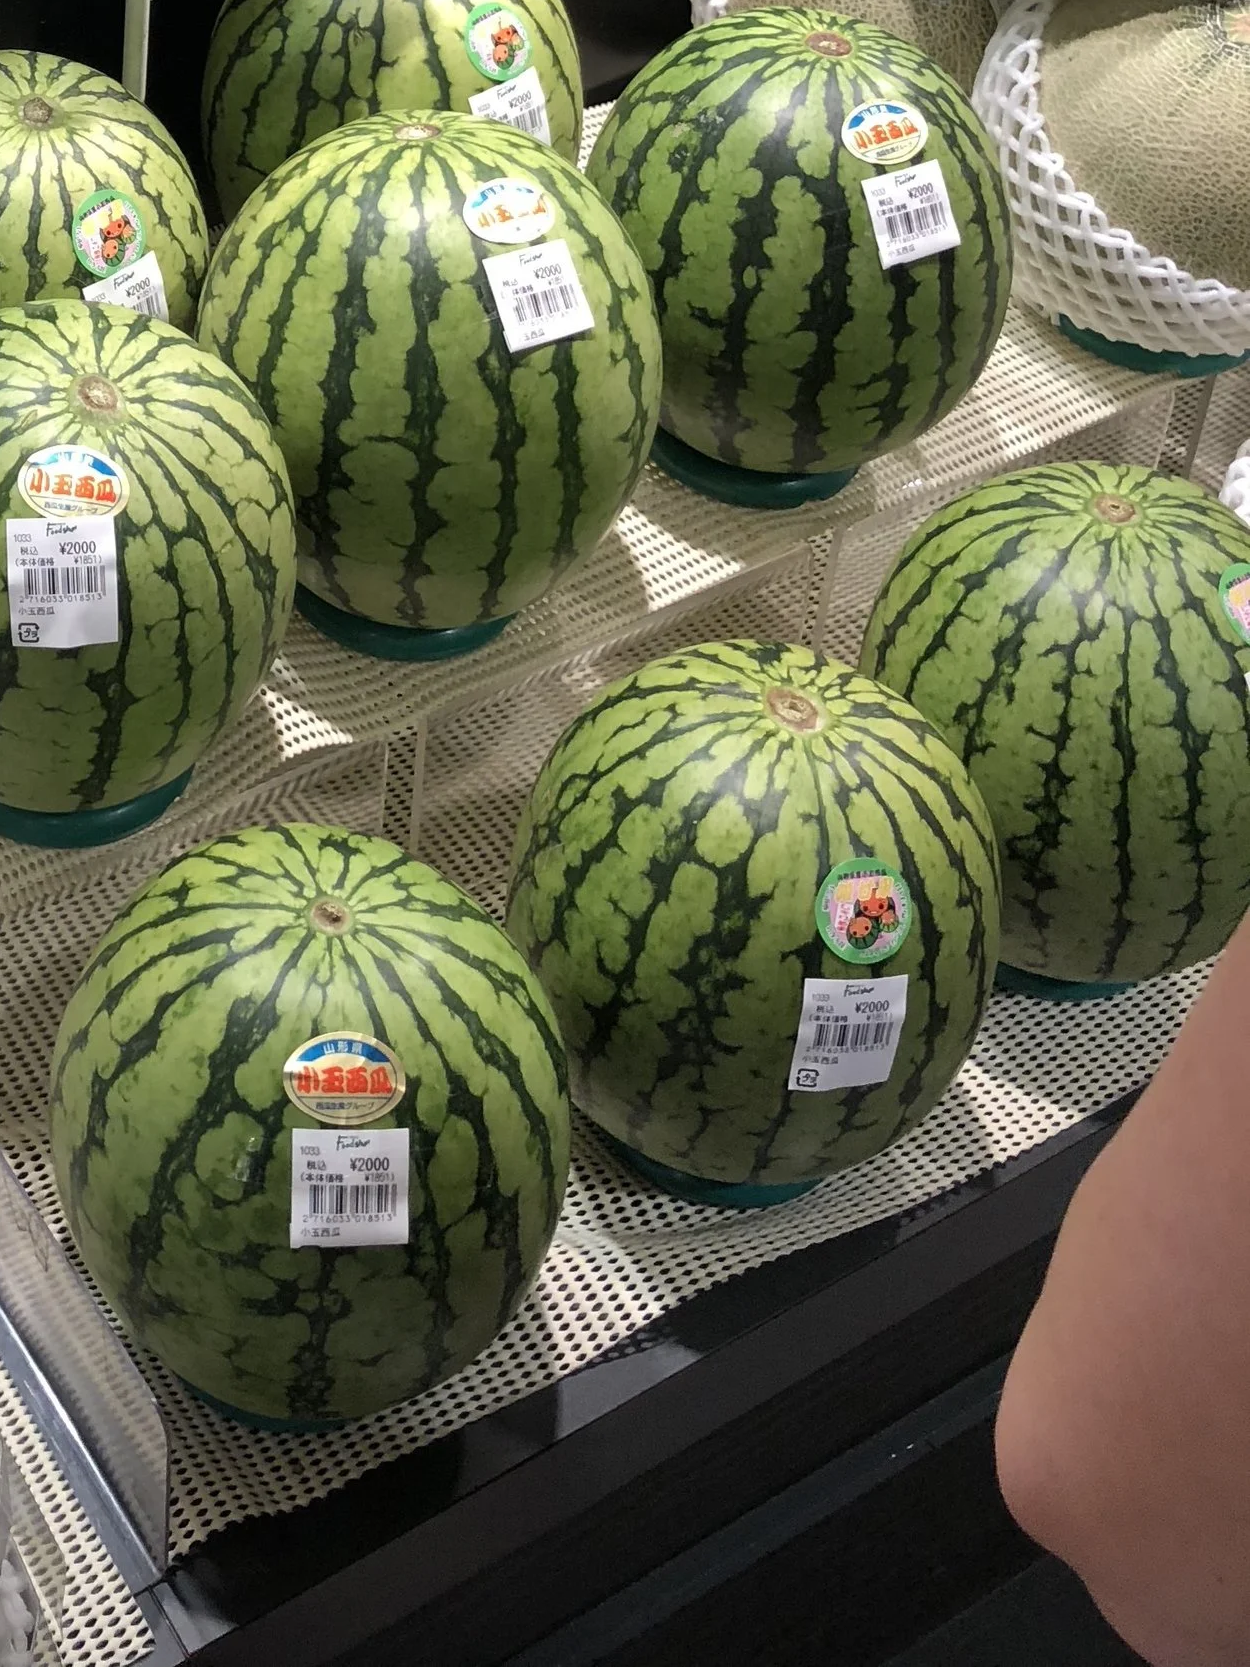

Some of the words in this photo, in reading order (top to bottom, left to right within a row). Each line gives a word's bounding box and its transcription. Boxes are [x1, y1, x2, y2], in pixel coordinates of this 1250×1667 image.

[907, 183, 934, 199] ¥2000
[533, 264, 562, 279] ¥2000
[126, 277, 151, 298] ¥2000
[29, 468, 117, 504] 小玉西瓜
[59, 541, 97, 555] ¥2000
[855, 1000, 890, 1014] ¥2000
[296, 1065, 393, 1094] 小玉西瓜
[350, 1157, 390, 1172] ¥2000
